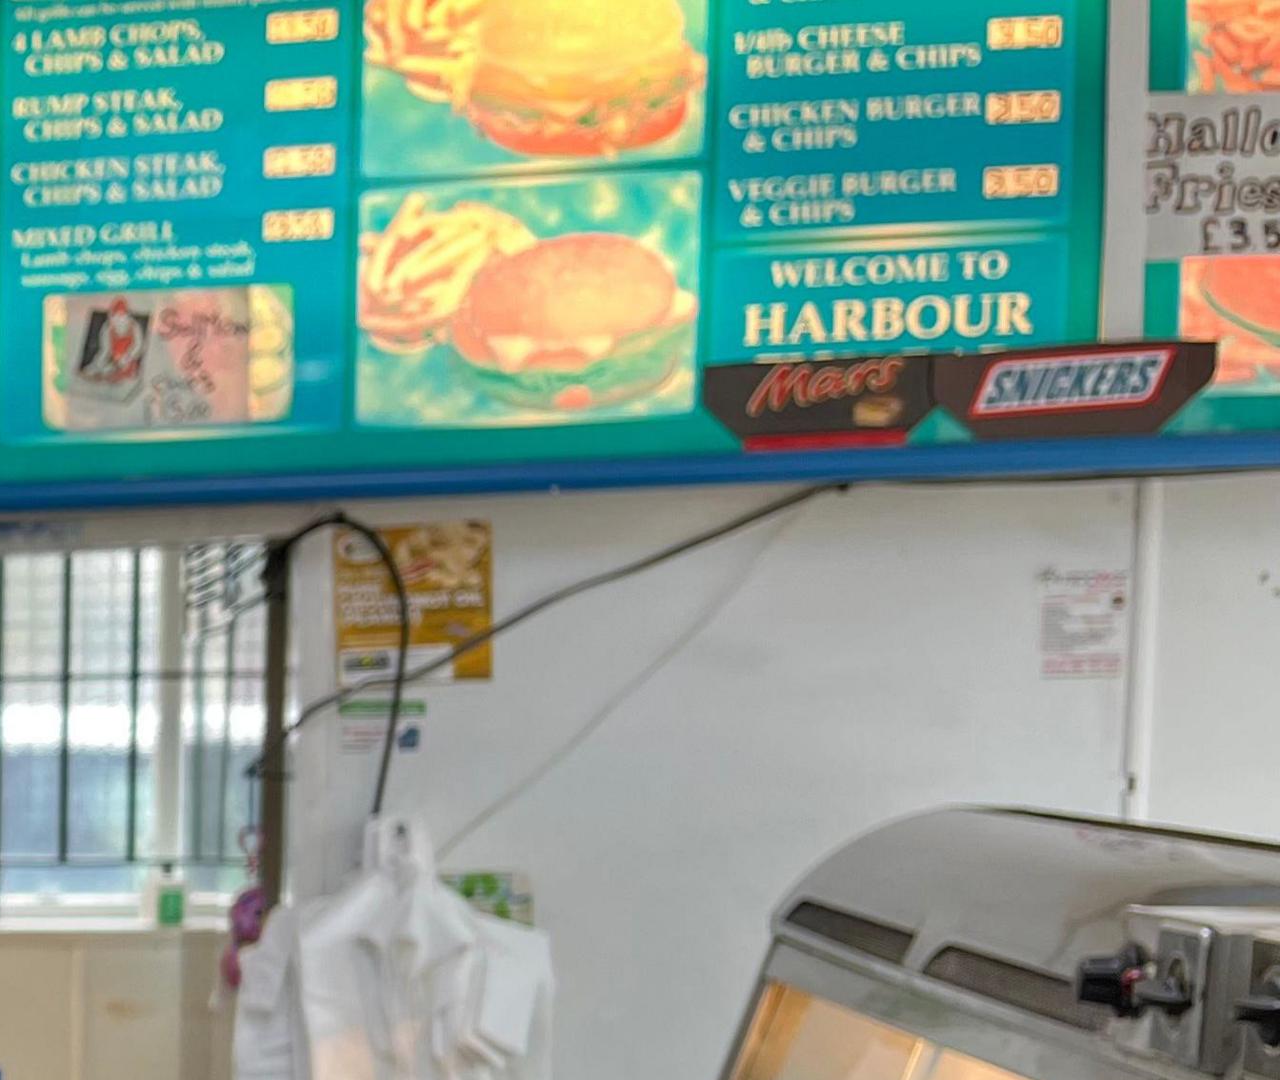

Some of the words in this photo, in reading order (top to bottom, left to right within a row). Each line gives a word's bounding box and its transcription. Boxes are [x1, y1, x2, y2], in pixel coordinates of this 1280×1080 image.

[31, 26, 107, 52] LAMB
[797, 21, 905, 50] CHEESE
[25, 50, 103, 77] CHIPS
[107, 49, 129, 71] &
[134, 40, 225, 67] SALAD
[747, 50, 861, 79] BURGER
[866, 49, 889, 72] &
[895, 43, 982, 70] CHIPS
[11, 93, 90, 120] RUMP
[728, 99, 859, 129] CHICKEN
[866, 91, 982, 121] BURGER
[23, 116, 103, 142] CHIPS
[106, 115, 128, 138] &
[133, 107, 224, 135] SALAD
[743, 131, 766, 153] &
[771, 124, 858, 152] CHIPS
[10, 156, 130, 184] CHICKEN
[728, 174, 835, 202] VEGGIE
[842, 168, 957, 197] BURGER
[23, 183, 102, 208] CHIPS
[105, 182, 127, 204] &
[132, 174, 224, 201] SALAD
[740, 205, 763, 227] &
[768, 198, 855, 226] CHIPS
[11, 224, 96, 248] MIXED
[99, 219, 175, 243] GRILL
[770, 252, 950, 288] WELCOME
[957, 249, 1010, 281] TO
[743, 292, 1034, 348] HARBOUR
[745, 357, 905, 419] Mars
[987, 354, 1163, 407] SNICKERS
